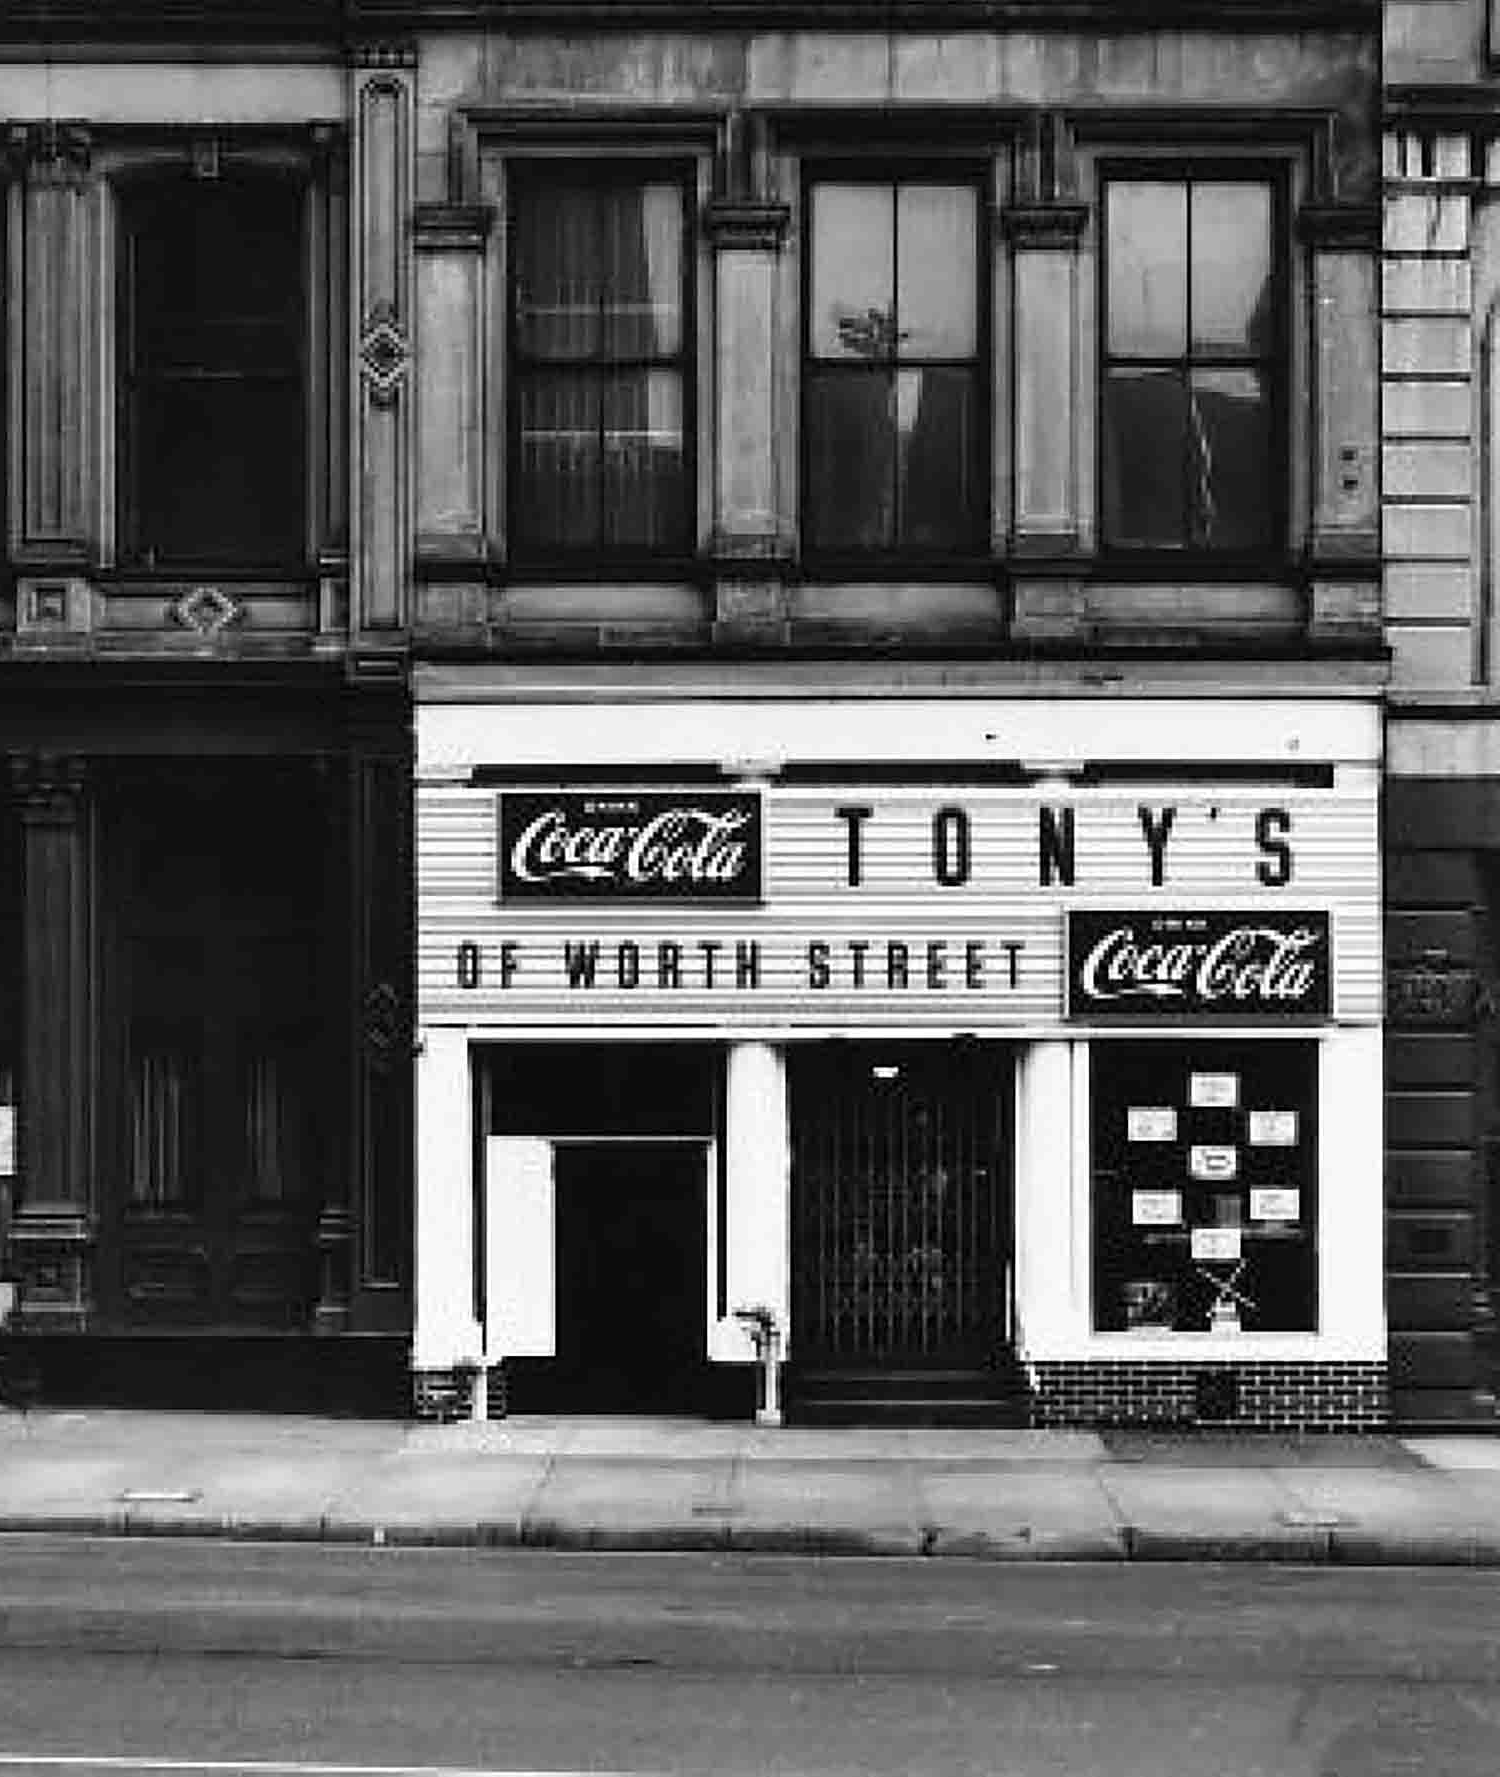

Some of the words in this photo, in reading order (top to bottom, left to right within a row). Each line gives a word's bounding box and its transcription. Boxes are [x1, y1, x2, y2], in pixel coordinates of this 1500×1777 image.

[835, 806, 1293, 887] TONY'S
[457, 941, 518, 990] OF
[565, 941, 762, 990] WORTH
[809, 941, 1026, 990] STREET
